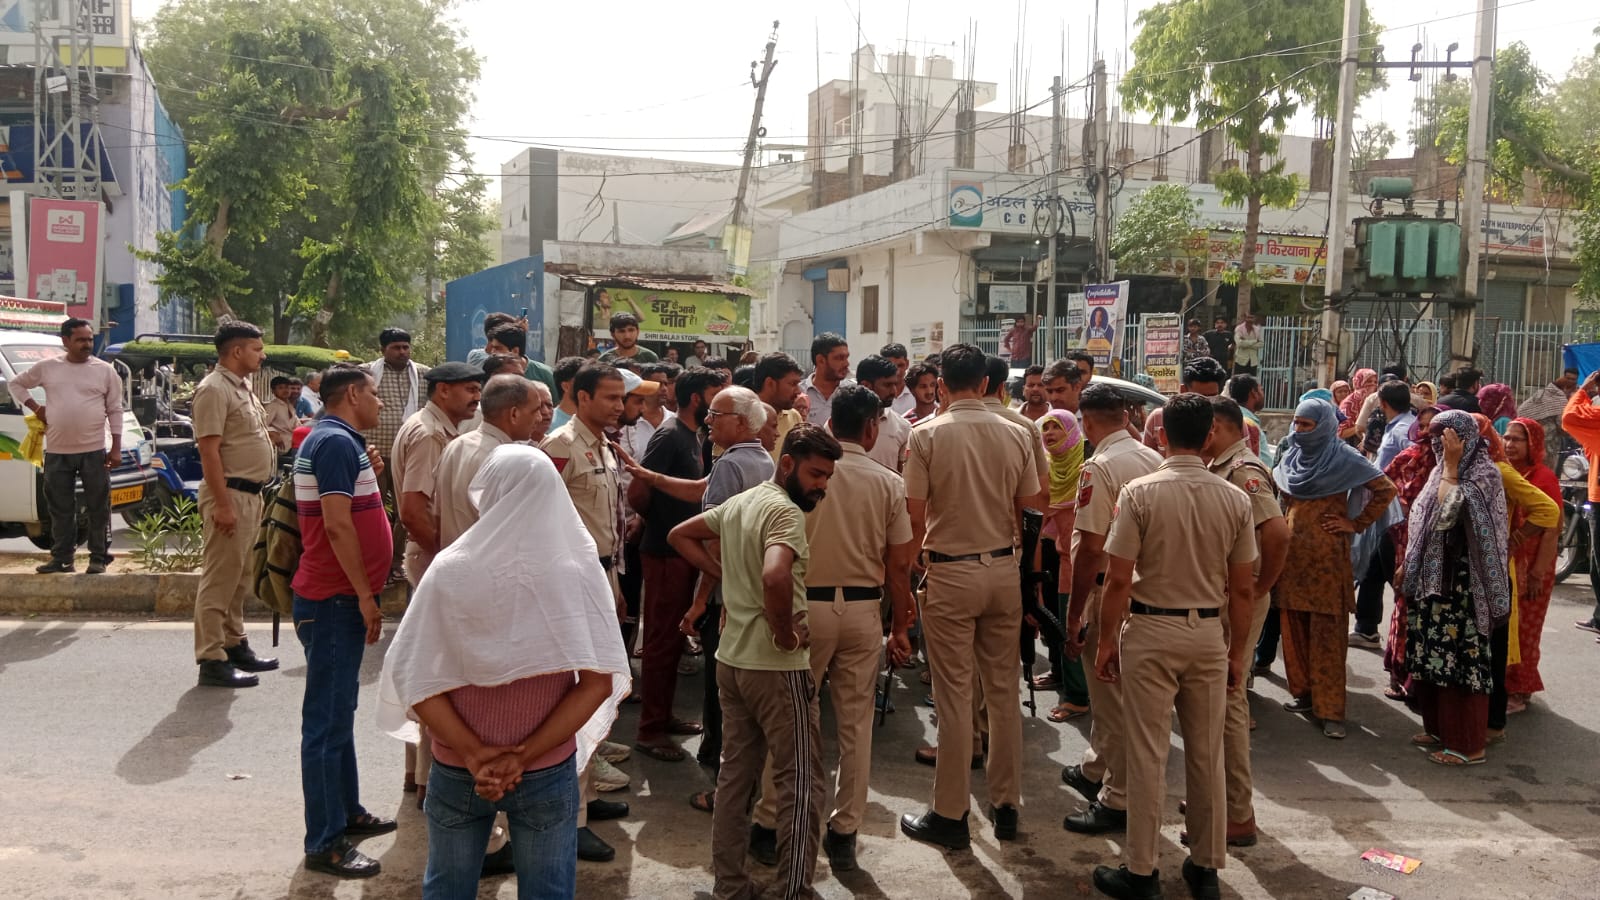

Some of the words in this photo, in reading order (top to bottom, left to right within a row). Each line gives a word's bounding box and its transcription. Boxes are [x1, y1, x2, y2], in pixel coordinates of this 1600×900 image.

[986, 196, 1027, 209] अटल
[1267, 240, 1310, 258] किरयाना
[652, 299, 672, 314] डर
[678, 304, 697, 315] आगे
[659, 310, 688, 328] जीत
[644, 333, 659, 341] SHRI
